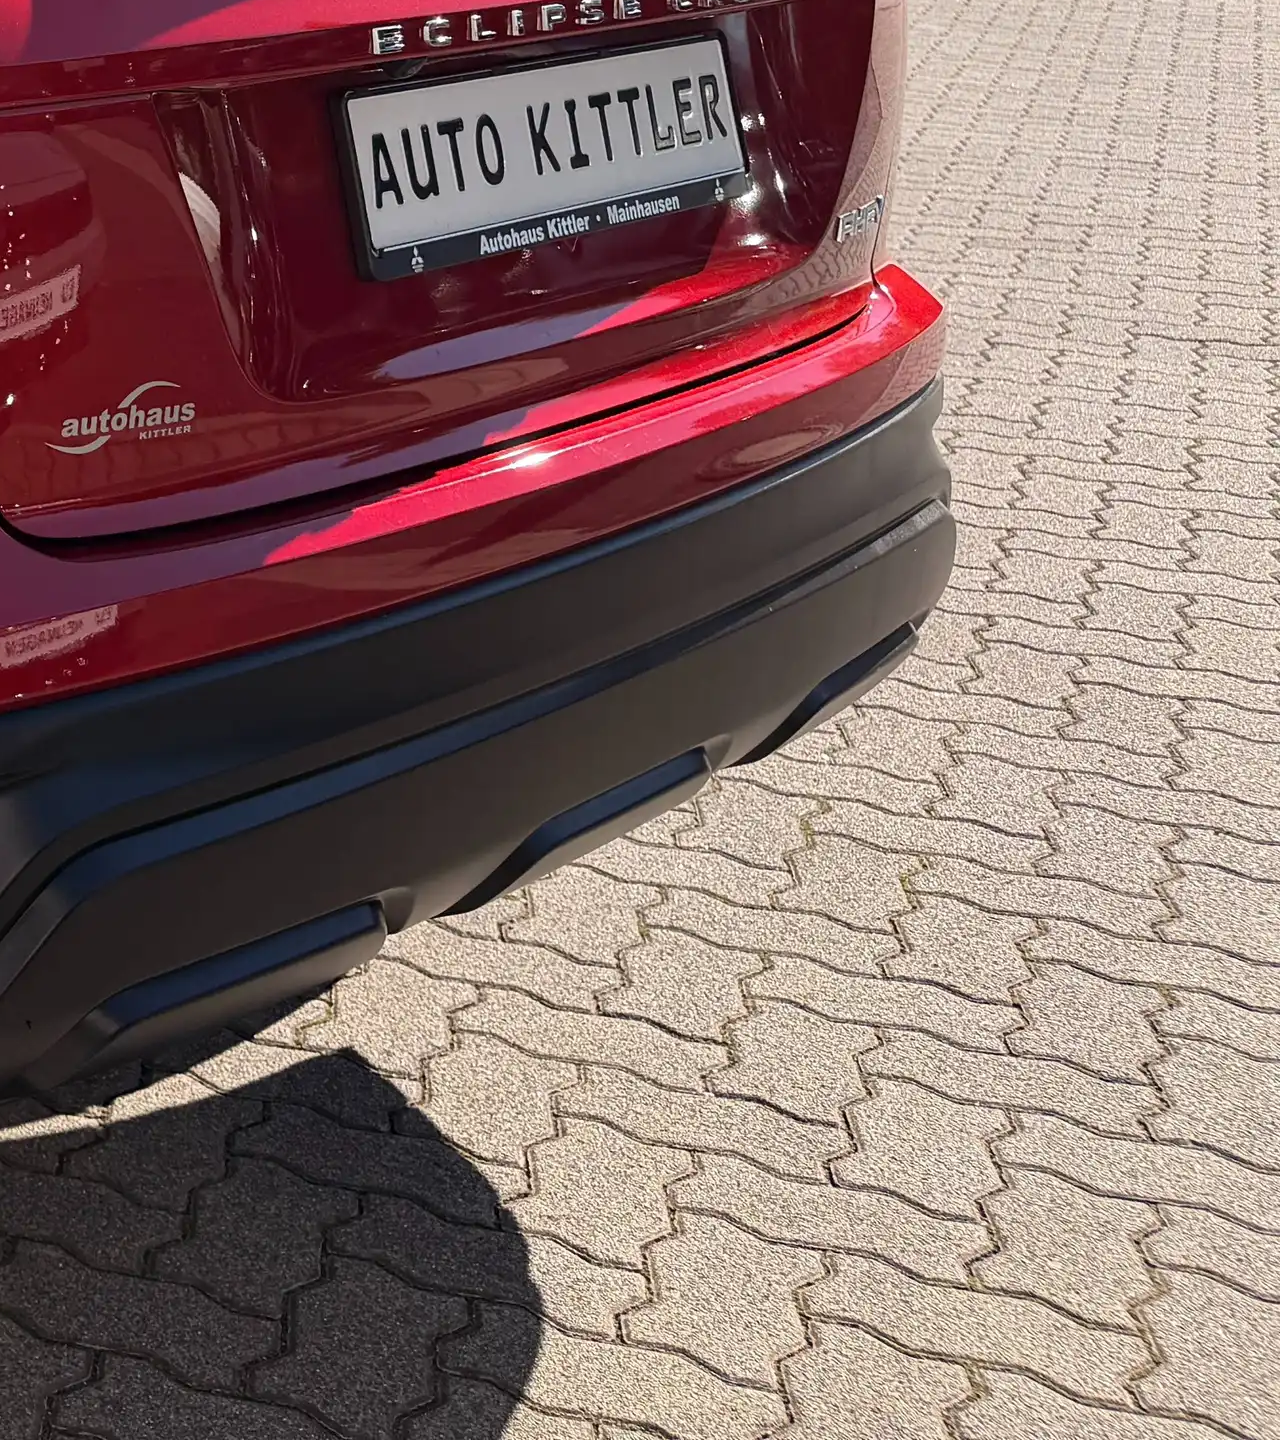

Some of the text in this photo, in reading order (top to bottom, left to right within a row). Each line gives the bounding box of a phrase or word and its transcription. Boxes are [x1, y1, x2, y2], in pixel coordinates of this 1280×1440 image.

[372, 73, 729, 209] AUTO KITTLER
[480, 194, 681, 256] Autohaus Kittler Mainhausen
[60, 402, 197, 438] autohaus
[139, 424, 193, 441] KITTLER
